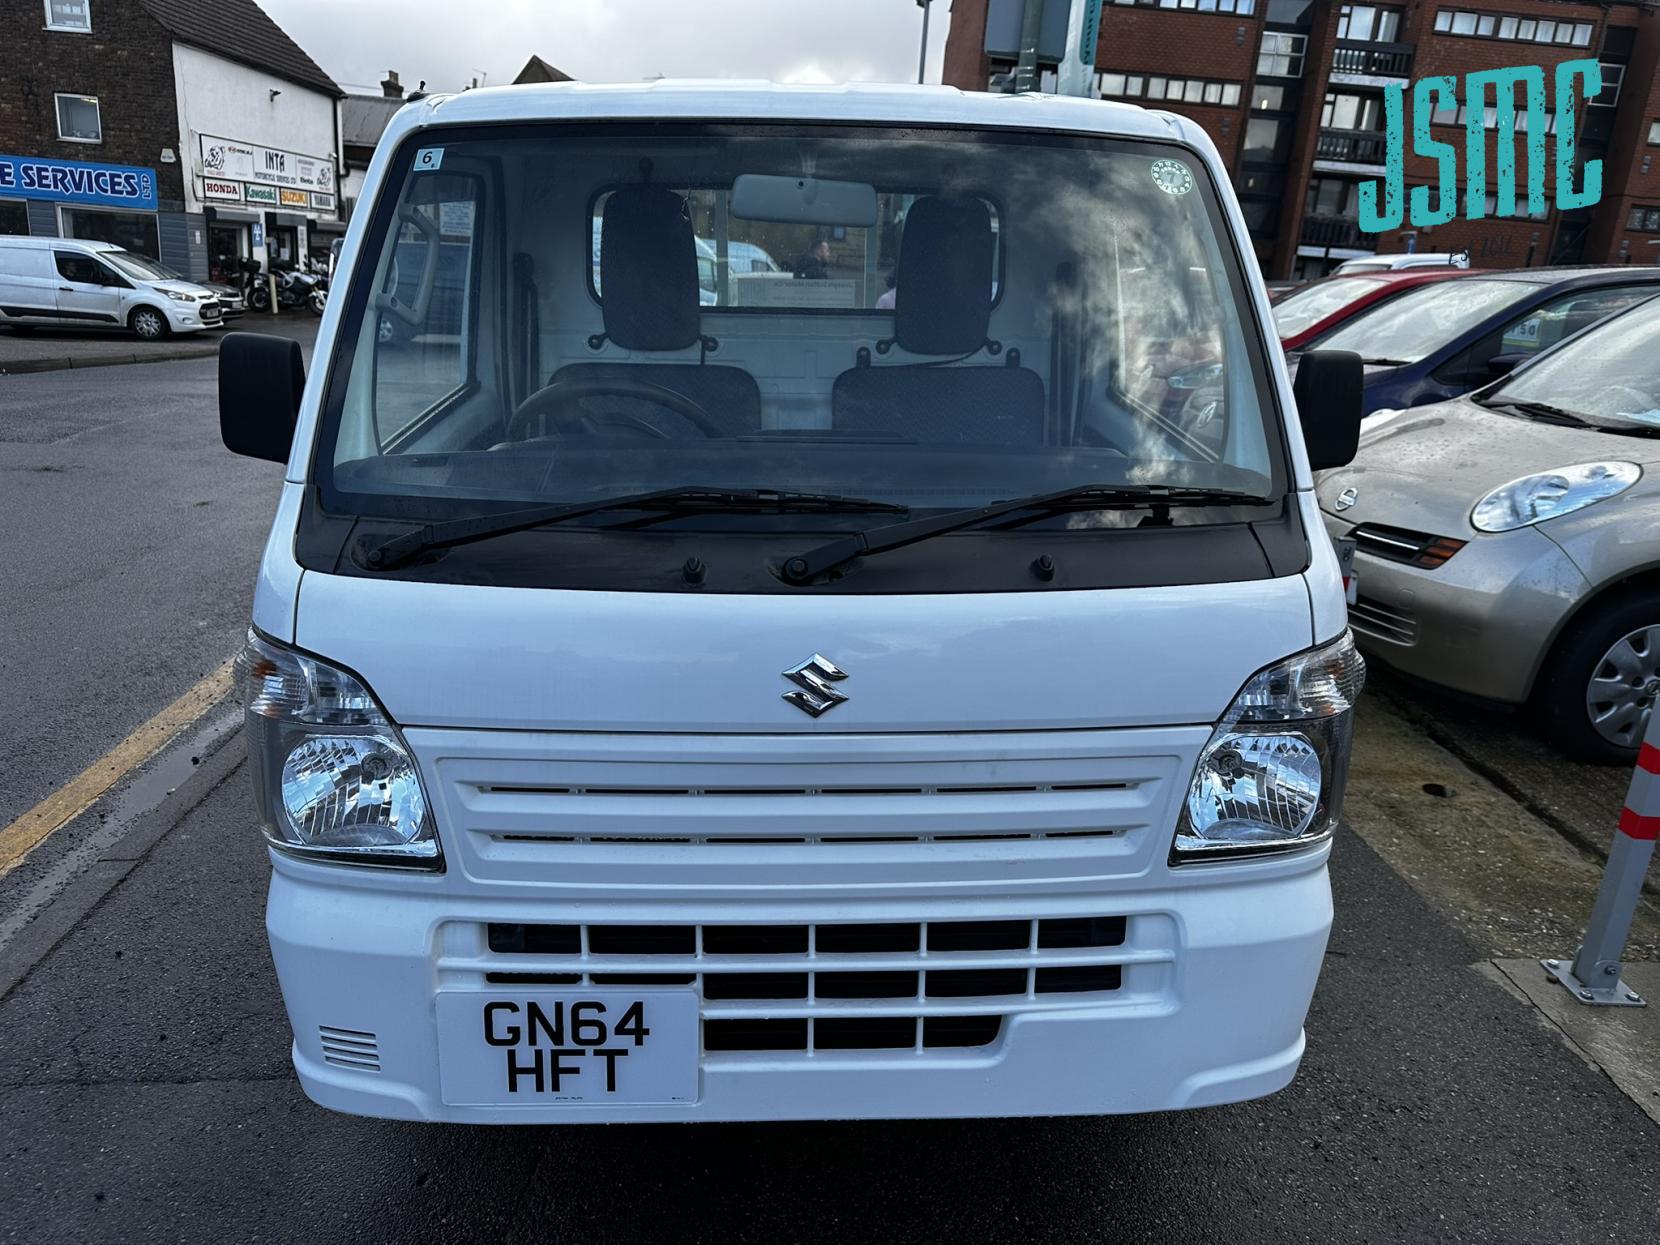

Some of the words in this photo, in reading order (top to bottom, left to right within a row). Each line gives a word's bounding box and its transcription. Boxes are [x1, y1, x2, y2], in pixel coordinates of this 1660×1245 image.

[265, 150, 286, 172] INTA
[422, 151, 433, 164] 6
[21, 163, 140, 198] SERVICES
[141, 173, 152, 199] LTD
[206, 182, 238, 195] HONDA
[246, 185, 276, 200] Kawasaki
[484, 1001, 650, 1046] GN64
[507, 1049, 628, 1092] HFT
